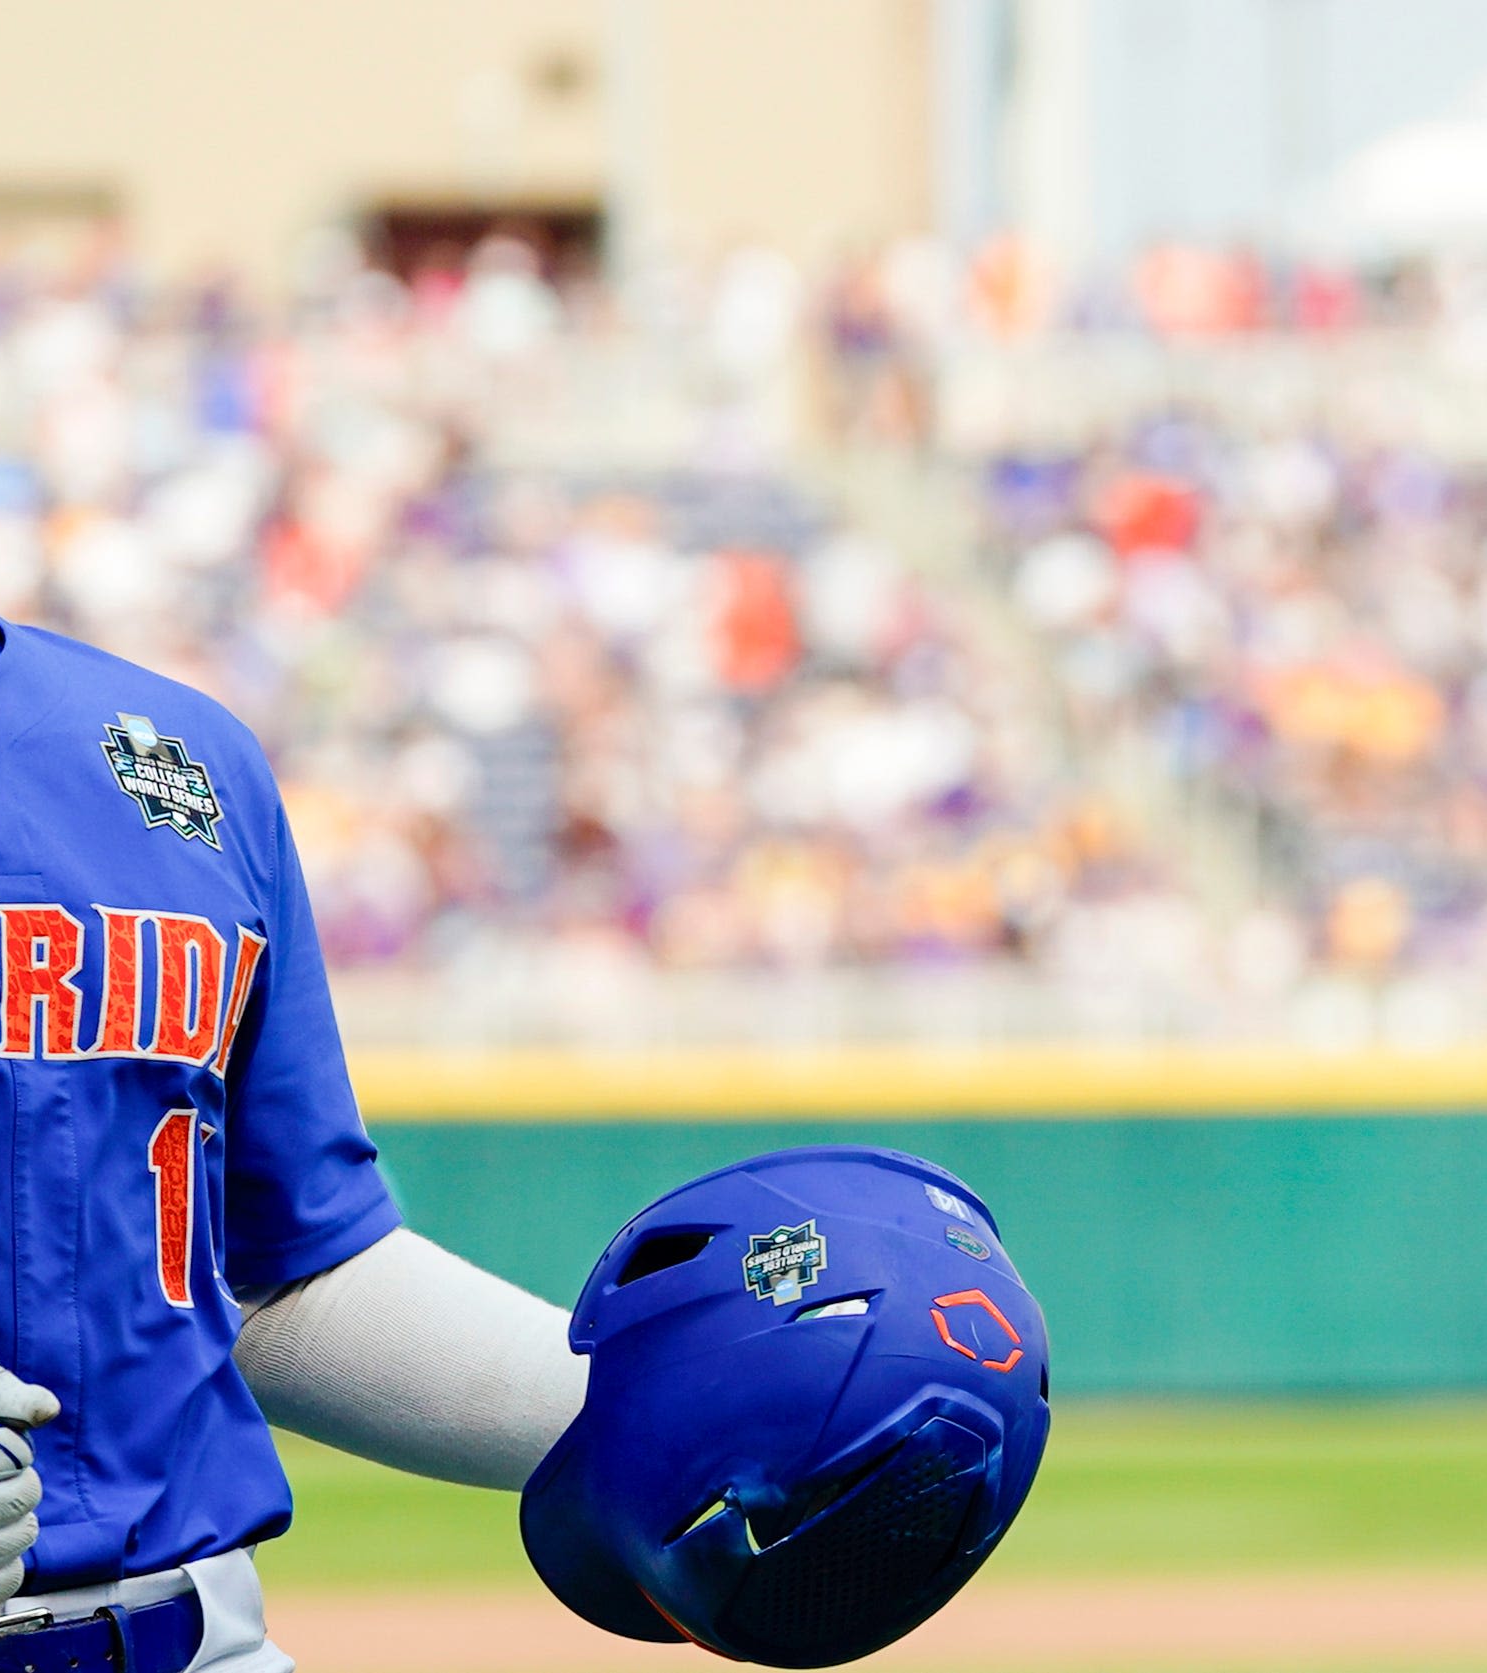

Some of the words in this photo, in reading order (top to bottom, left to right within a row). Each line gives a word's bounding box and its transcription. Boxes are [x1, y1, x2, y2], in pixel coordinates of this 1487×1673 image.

[134, 763, 189, 791] COLLEGE
[121, 775, 170, 800] WORLD
[170, 786, 215, 815] SERIES
[747, 1247, 782, 1268] SERIES
[783, 1240, 820, 1257] WORLD
[763, 1252, 804, 1274] COLLEGE
